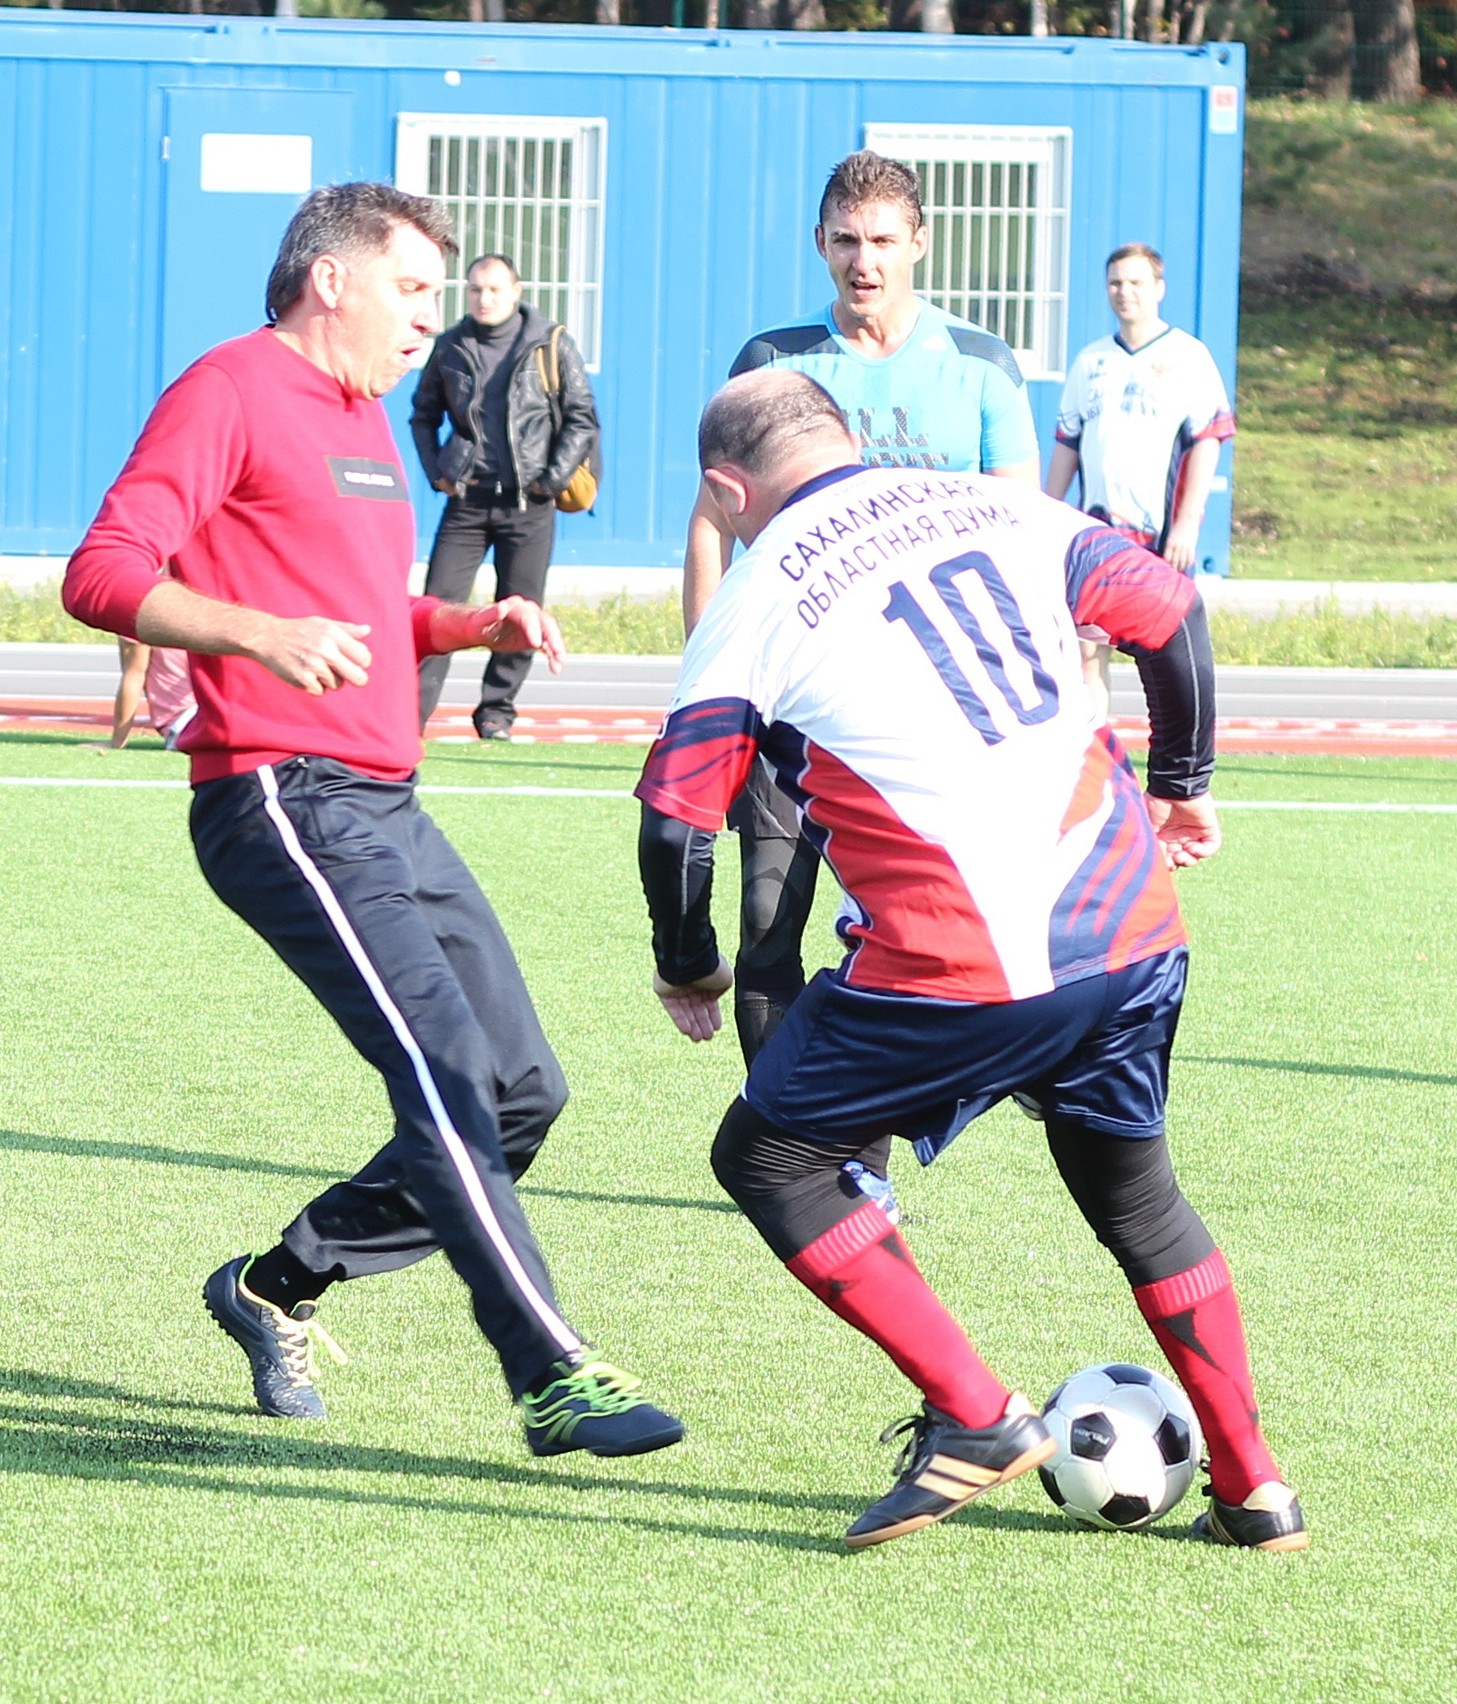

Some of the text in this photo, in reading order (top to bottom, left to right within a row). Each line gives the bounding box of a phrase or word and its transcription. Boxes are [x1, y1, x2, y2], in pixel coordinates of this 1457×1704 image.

[779, 480, 984, 582] САХАЛИНСКАЯ
[797, 504, 1024, 629] ОБЛАСТНАЯ ДУМА
[881, 550, 1059, 747] 10
